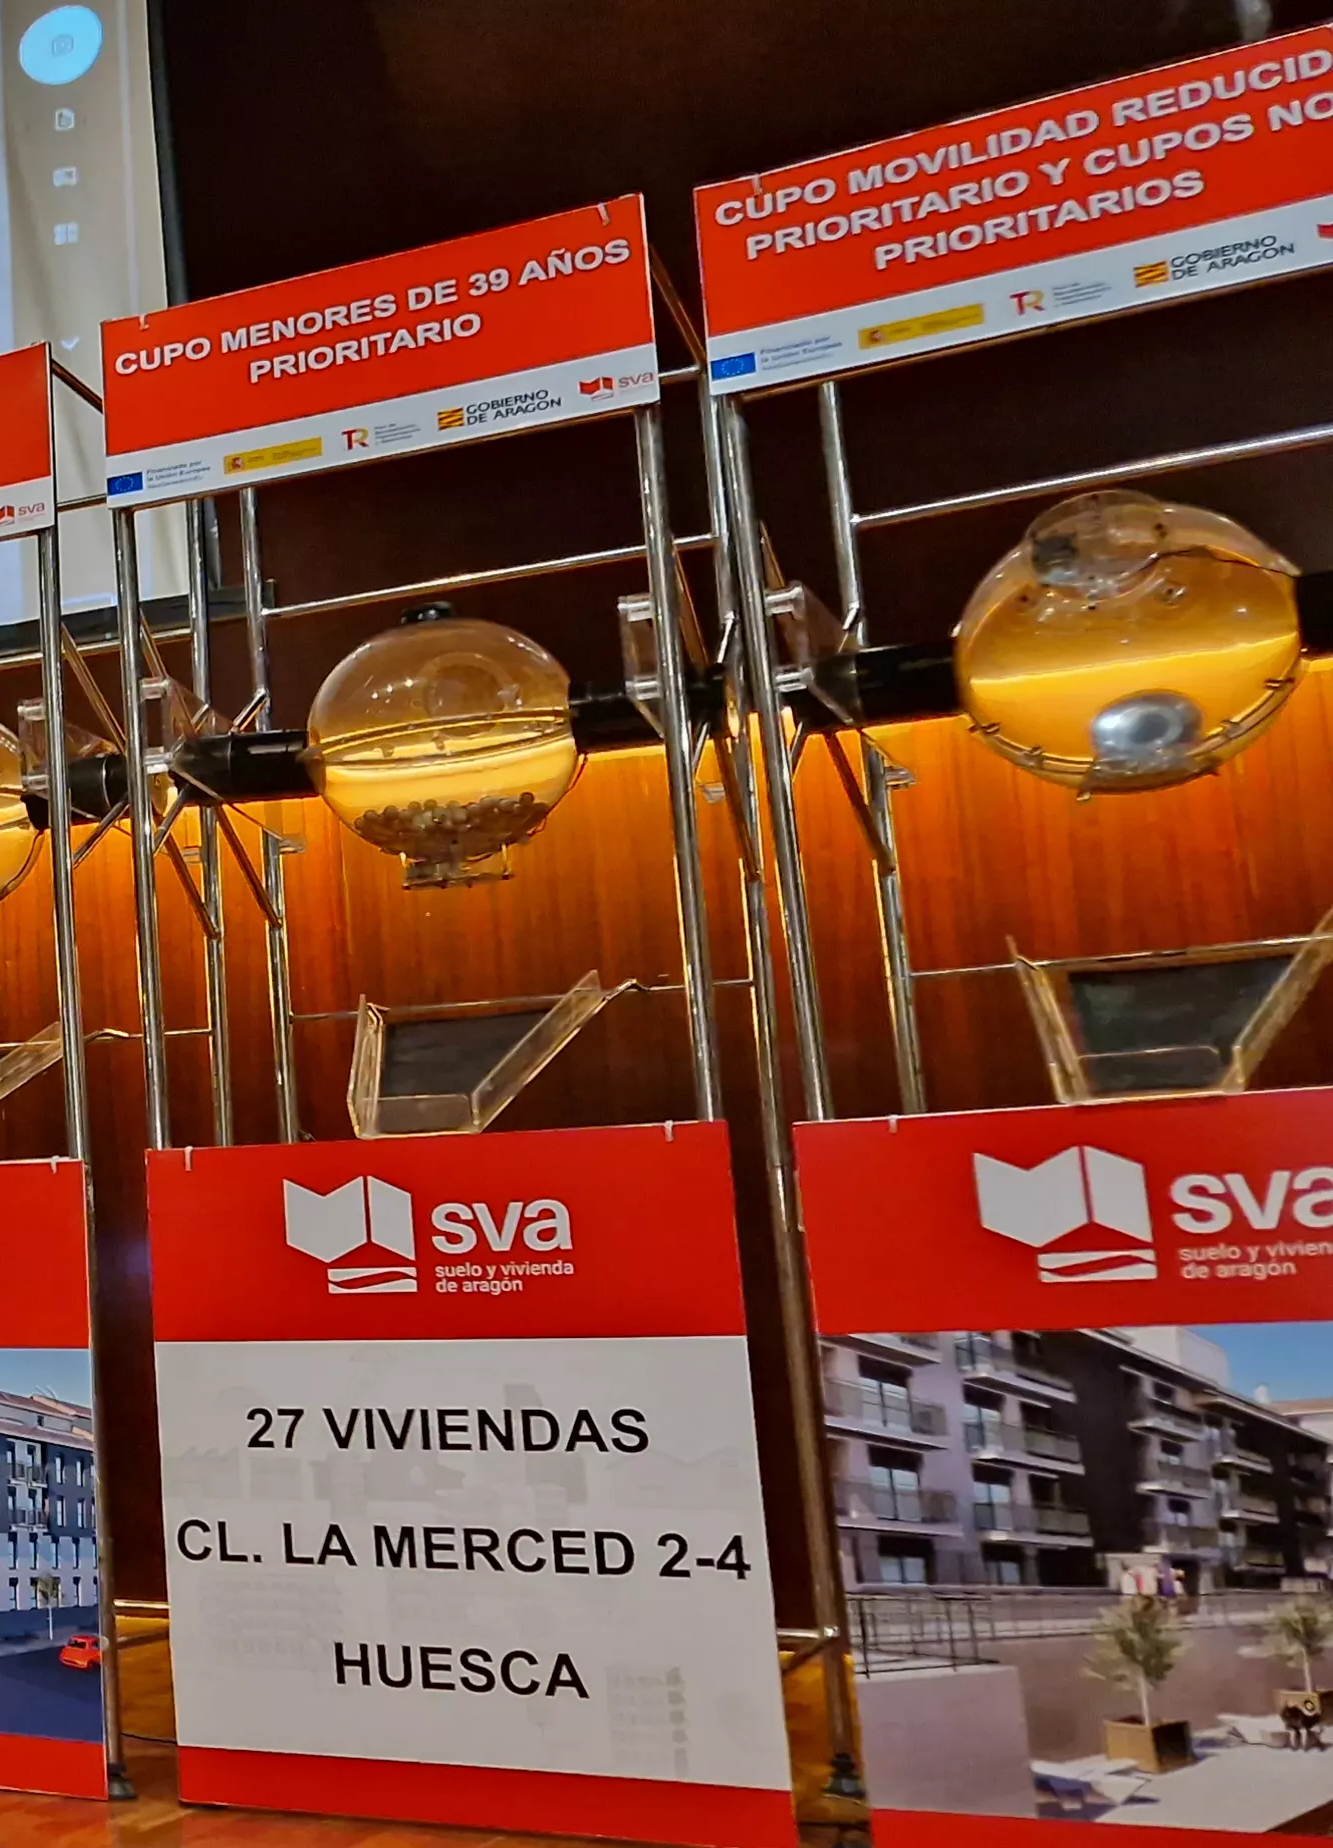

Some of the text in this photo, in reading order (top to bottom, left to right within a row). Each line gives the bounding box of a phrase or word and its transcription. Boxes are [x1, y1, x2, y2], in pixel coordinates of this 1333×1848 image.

[715, 49, 1333, 227] CUPO MOVILIDAD REDUCID
[746, 170, 1030, 260] PRIORITARIO
[1039, 158, 1070, 186] Y
[1084, 114, 1254, 175] CUPOS
[874, 170, 1204, 270] PRIORITARIOS
[1170, 235, 1277, 268] GOBIERNO
[1171, 267, 1197, 281] DE
[115, 237, 631, 375] CUPO MENORES DE 39 AÑOS
[249, 312, 482, 384] PRIORITARIO
[618, 372, 654, 389] sva
[466, 389, 549, 415] GOBIERNO
[466, 413, 487, 426] DE
[18, 502, 46, 517] sva
[1169, 1166, 1333, 1235] sva
[431, 1199, 573, 1254] sva
[435, 1259, 574, 1280] suelo y vivienda
[1179, 1243, 1242, 1261] suelo
[1246, 1245, 1260, 1263] y
[1181, 1258, 1298, 1280] de aragón
[435, 1276, 523, 1296] de aragón
[245, 1407, 650, 1455] 27 VIVIENDAS
[175, 1518, 753, 1582] CL. LA MERCED 2-4
[333, 1641, 591, 1702] HUESCA
